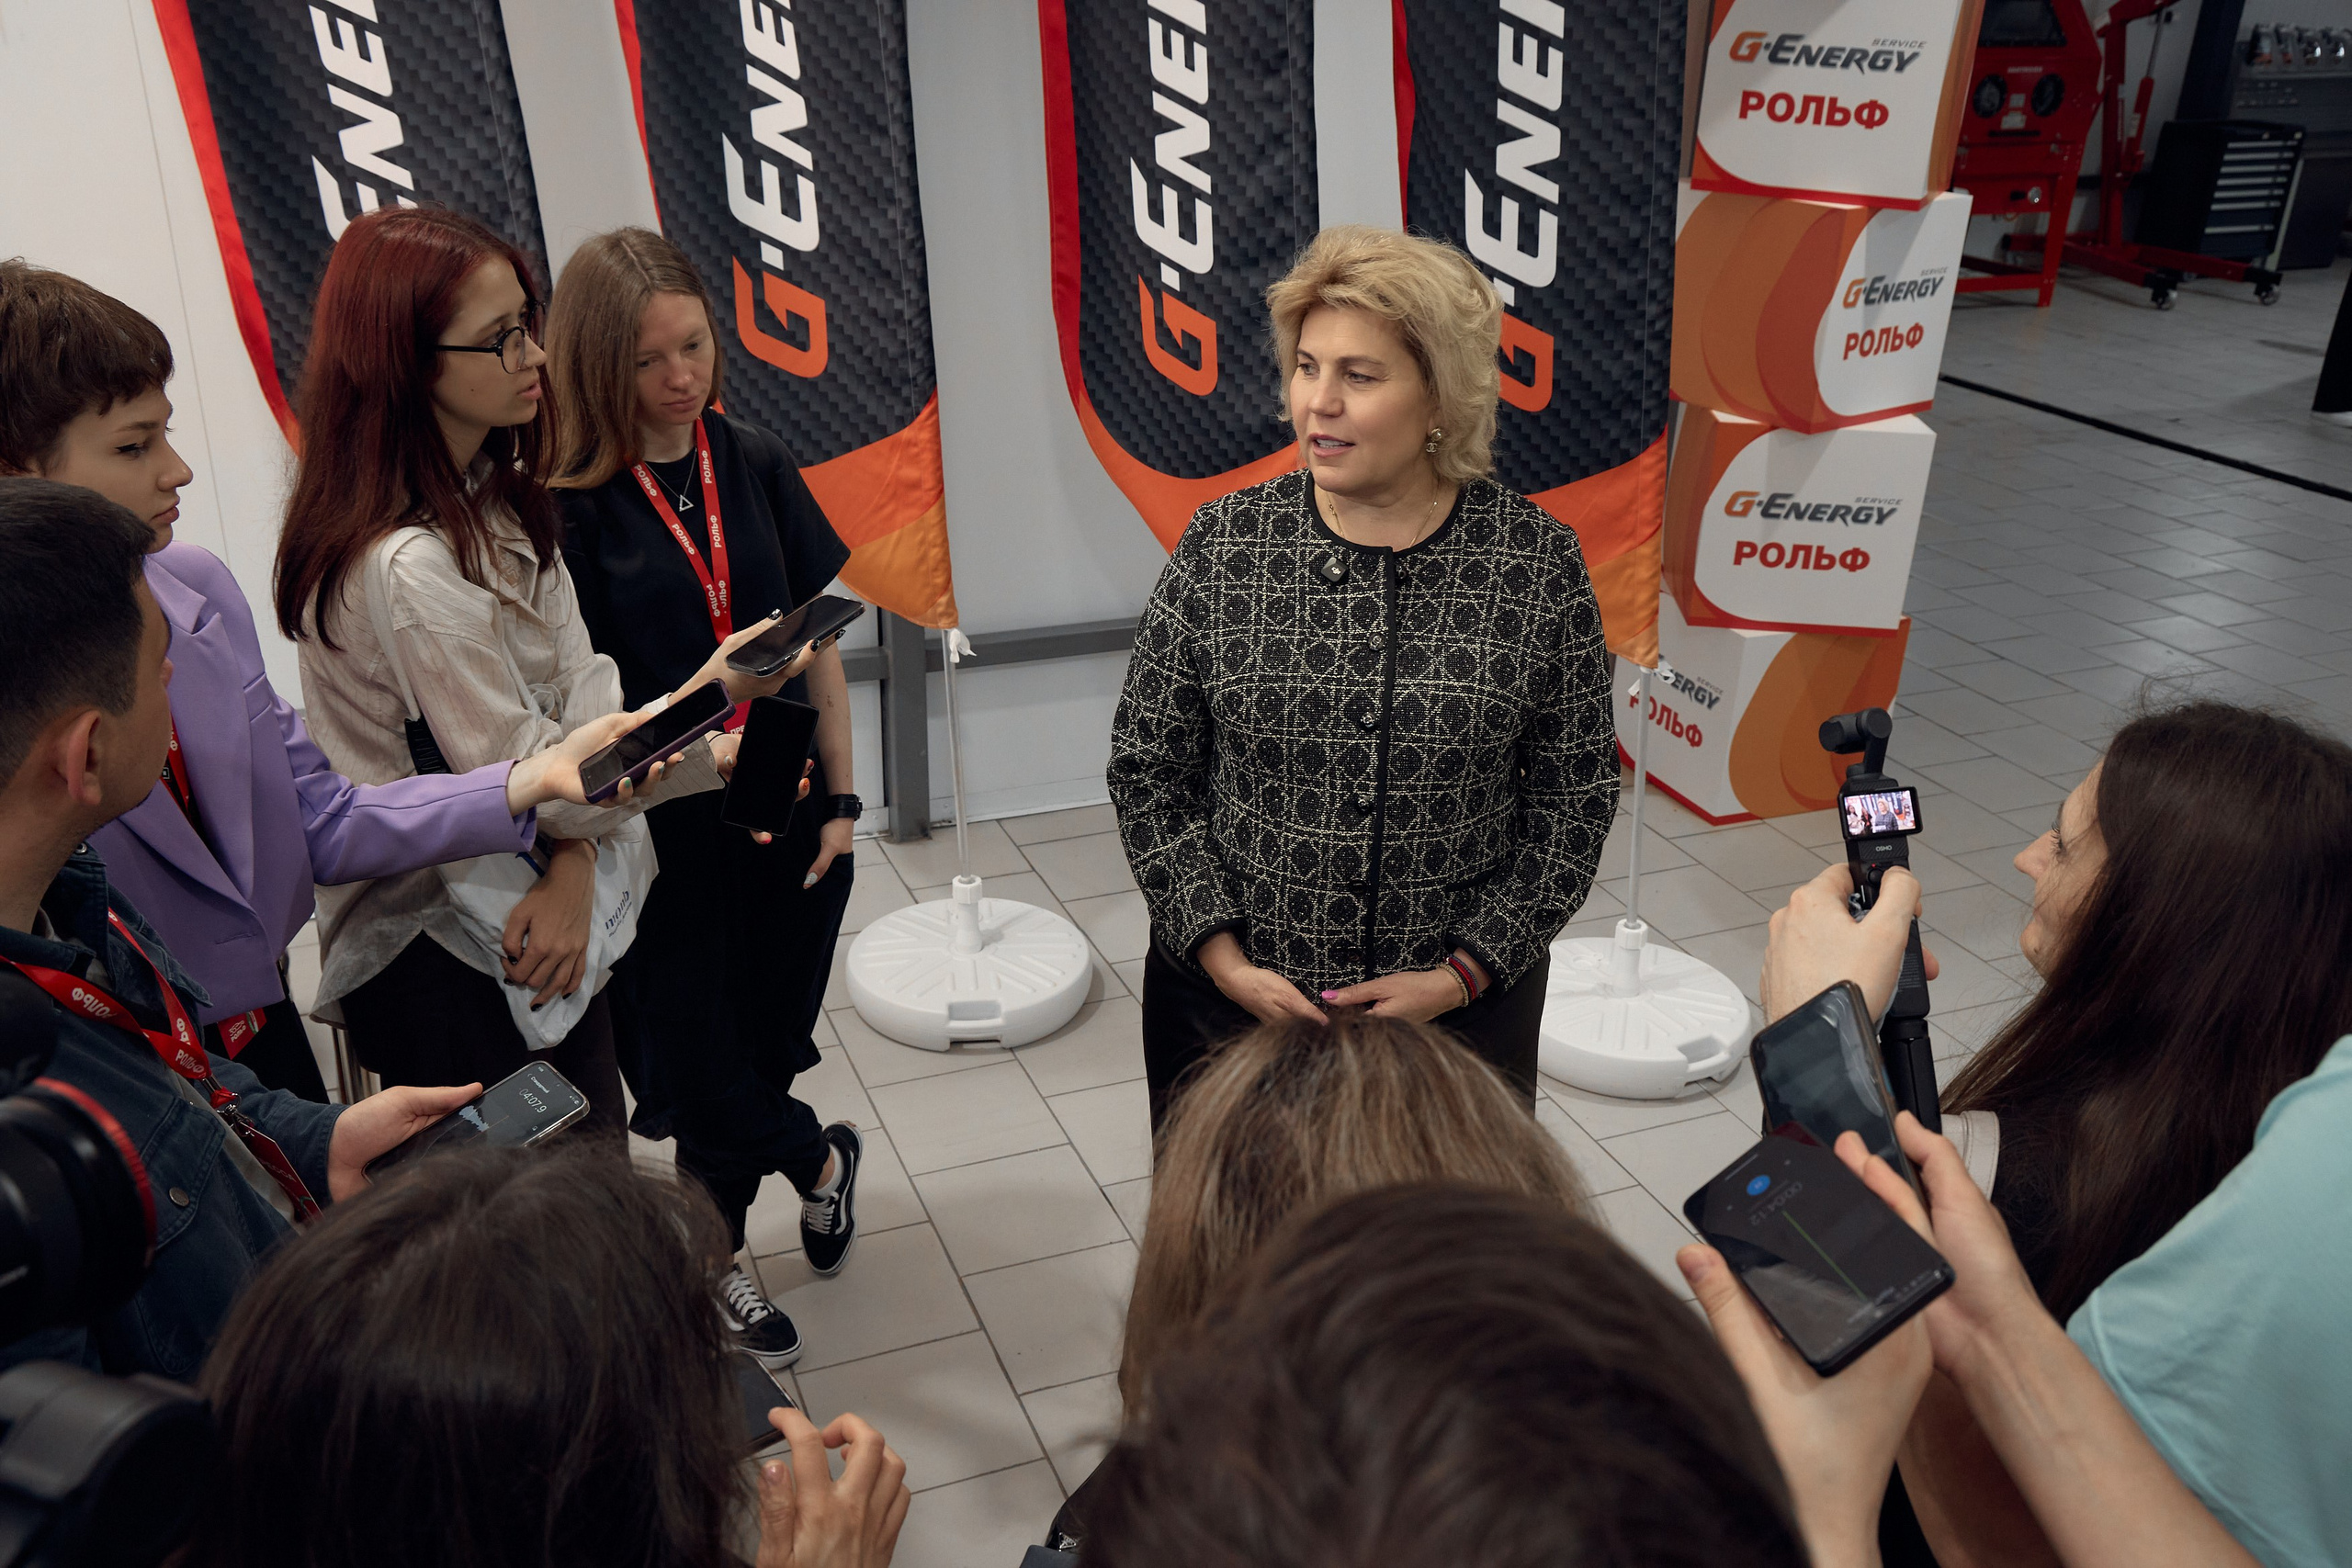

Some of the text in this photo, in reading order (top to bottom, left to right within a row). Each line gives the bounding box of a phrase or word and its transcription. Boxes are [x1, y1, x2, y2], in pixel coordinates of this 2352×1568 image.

[1871, 38, 1928, 49] SERVICE
[1738, 89, 1889, 130] РОЛЬФ
[722, 0, 829, 378] G-ENE
[1843, 321, 1924, 361] РОЛЬФ
[634, 464, 658, 497] РОЛЬФ
[701, 450, 713, 484] РОЛЬФ
[1854, 496, 1904, 506] SERVICE
[672, 523, 695, 555] РОЛЬФ
[709, 514, 722, 548] РОЛЬФ
[1733, 540, 1871, 572] РОЛЬФ
[706, 583, 721, 617] РОЛЬФ
[1664, 668, 1721, 710] ERGY
[175, 1049, 204, 1073] РОЛЬФ
